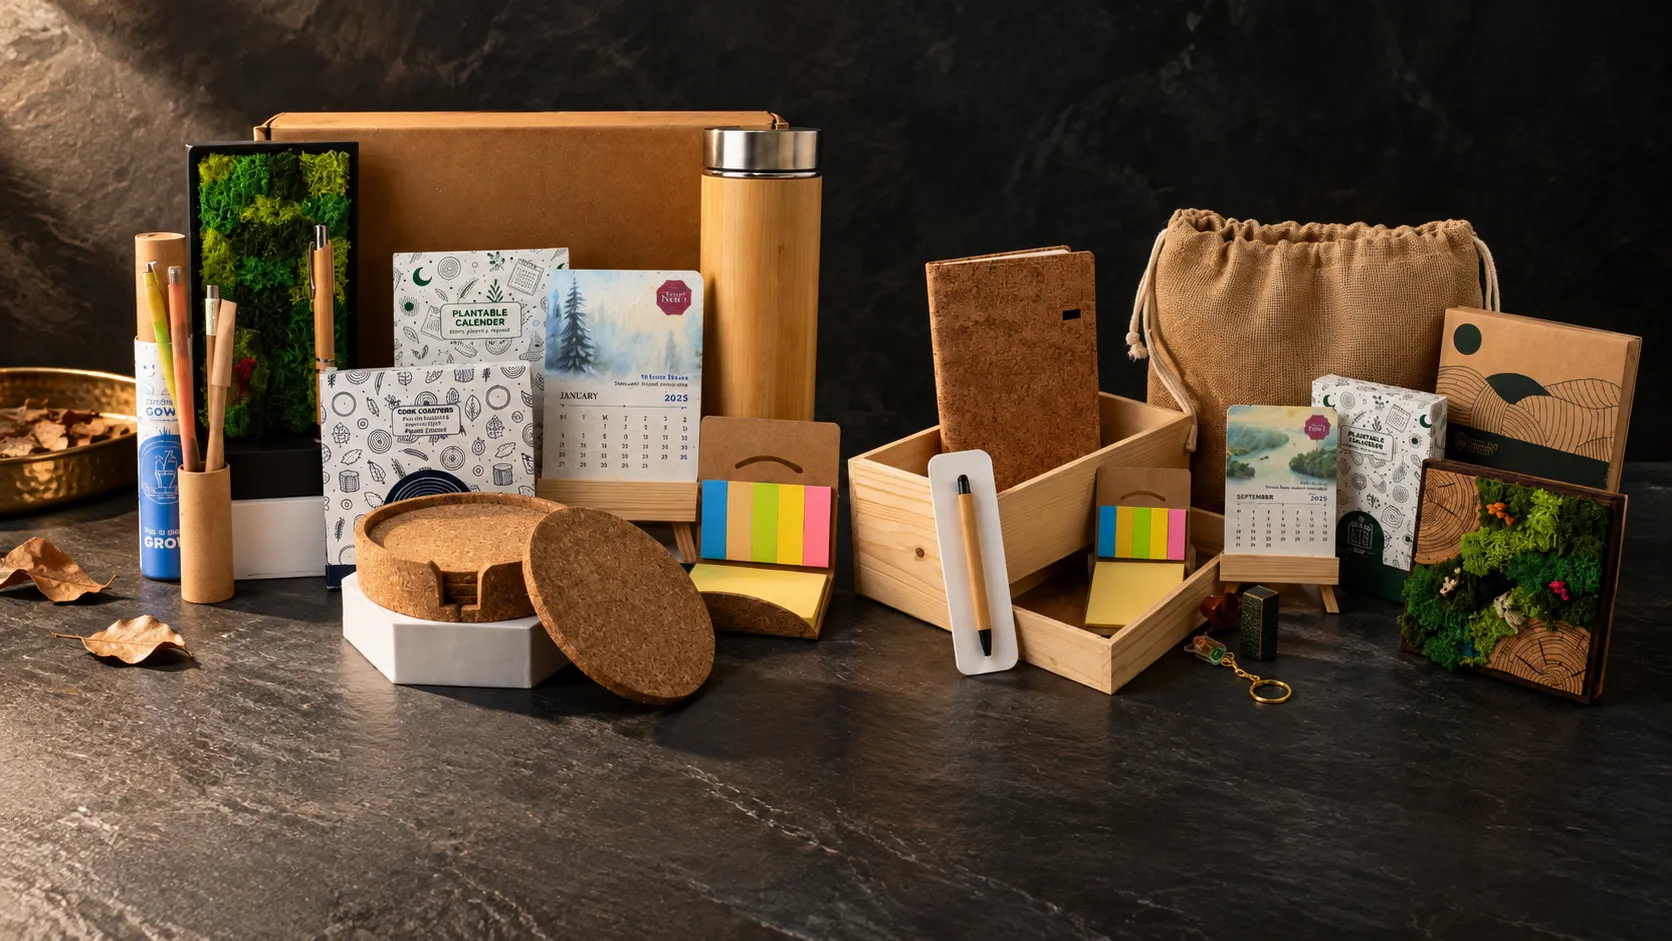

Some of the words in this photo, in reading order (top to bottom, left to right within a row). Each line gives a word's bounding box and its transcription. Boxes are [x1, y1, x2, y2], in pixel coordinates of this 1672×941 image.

[452, 308, 508, 318] PLANTABLE
[455, 318, 505, 327] CALENDER
[560, 392, 598, 400] JANUARY
[664, 394, 689, 402] 2025
